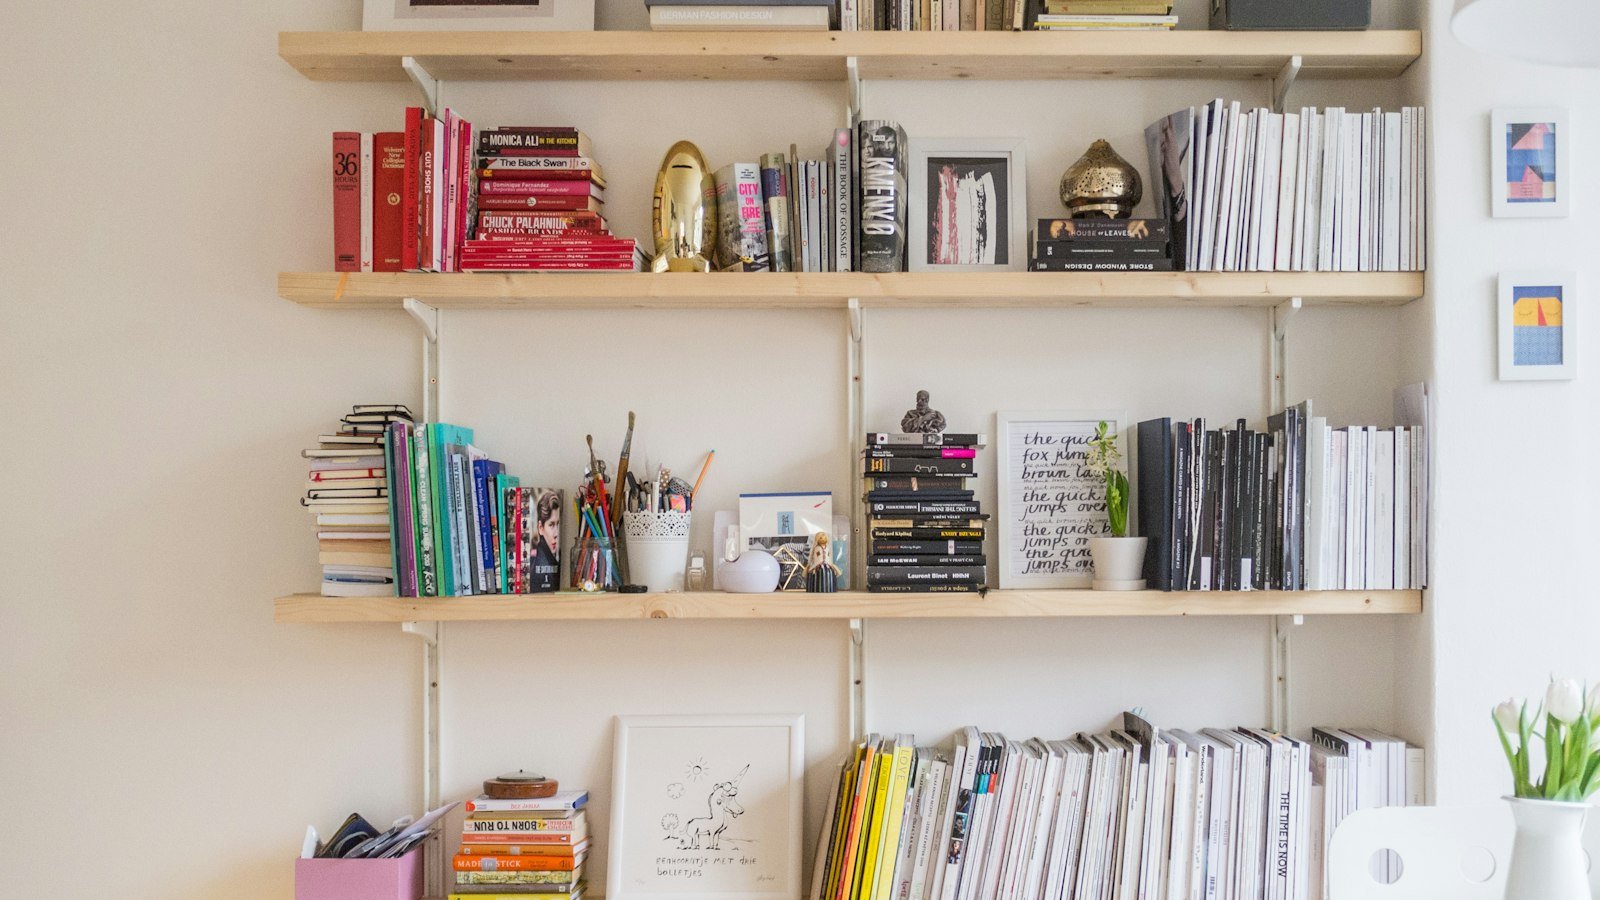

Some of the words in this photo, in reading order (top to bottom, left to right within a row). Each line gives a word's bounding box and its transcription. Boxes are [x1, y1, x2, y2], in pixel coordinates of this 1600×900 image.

[490, 134, 522, 146] MONICA
[525, 135, 539, 146] ALI
[335, 152, 358, 176] 36
[739, 184, 758, 195] CITY
[746, 198, 754, 206] ON
[742, 207, 760, 219] FIRE
[840, 203, 846, 215] OF
[483, 217, 513, 228] CHUCK
[516, 217, 567, 229] PALAHNIUK
[1024, 432, 1057, 445] the
[1023, 449, 1048, 464] fox
[1023, 488, 1050, 502] the
[1055, 488, 1100, 509] quick
[1018, 502, 1066, 521] jumps
[1078, 503, 1108, 512] over
[1024, 524, 1051, 536] the
[1056, 523, 1097, 541] quick
[1020, 537, 1069, 551] jumps
[1026, 549, 1054, 558] the
[1022, 560, 1070, 574] jumps
[897, 750, 909, 780] LOVE
[1280, 792, 1290, 810] THE
[474, 821, 494, 831] RUN
[497, 821, 509, 831] TO
[512, 821, 537, 831] BORN
[1279, 814, 1289, 836] TIME
[1278, 840, 1287, 848] IS
[1277, 851, 1287, 878] NOW
